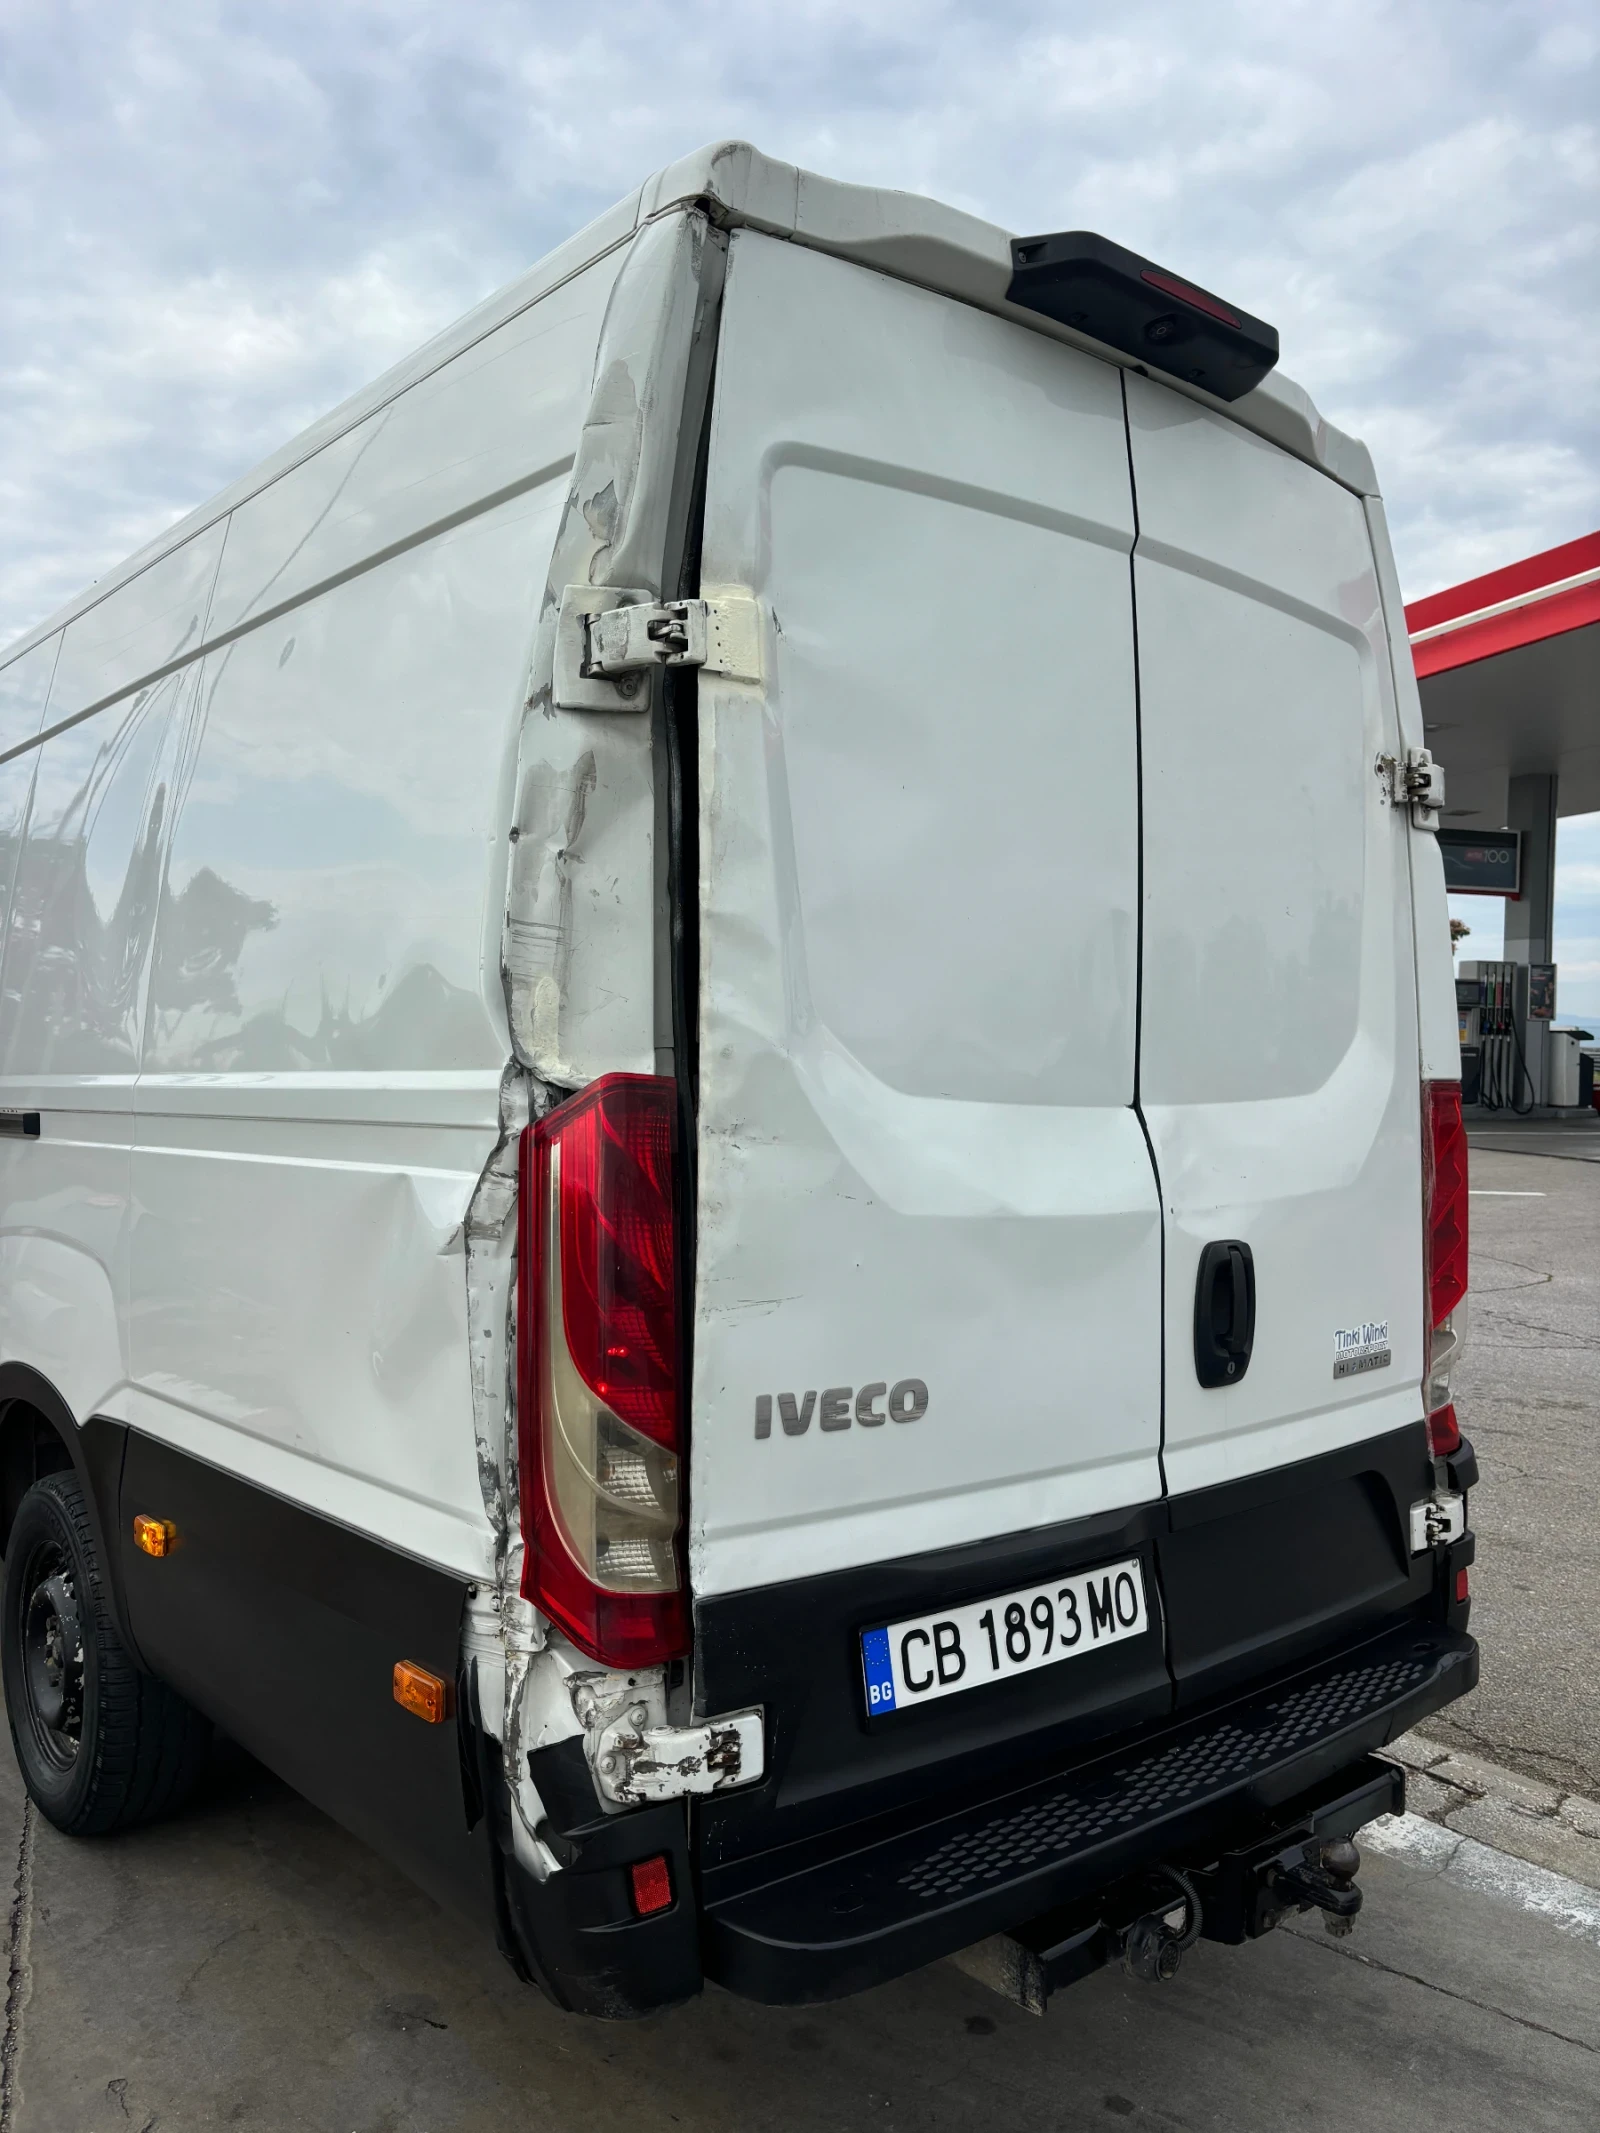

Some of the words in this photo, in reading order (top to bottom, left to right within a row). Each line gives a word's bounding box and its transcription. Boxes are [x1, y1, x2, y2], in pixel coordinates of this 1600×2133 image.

[1335, 1327, 1360, 1350] Tinki
[1362, 1321, 1388, 1345] Winki
[754, 1378, 929, 1440] IVECO
[900, 1620, 967, 1693] CB
[979, 1588, 1082, 1671] 1893
[1086, 1571, 1139, 1640] MO
[869, 1681, 893, 1705] BG
